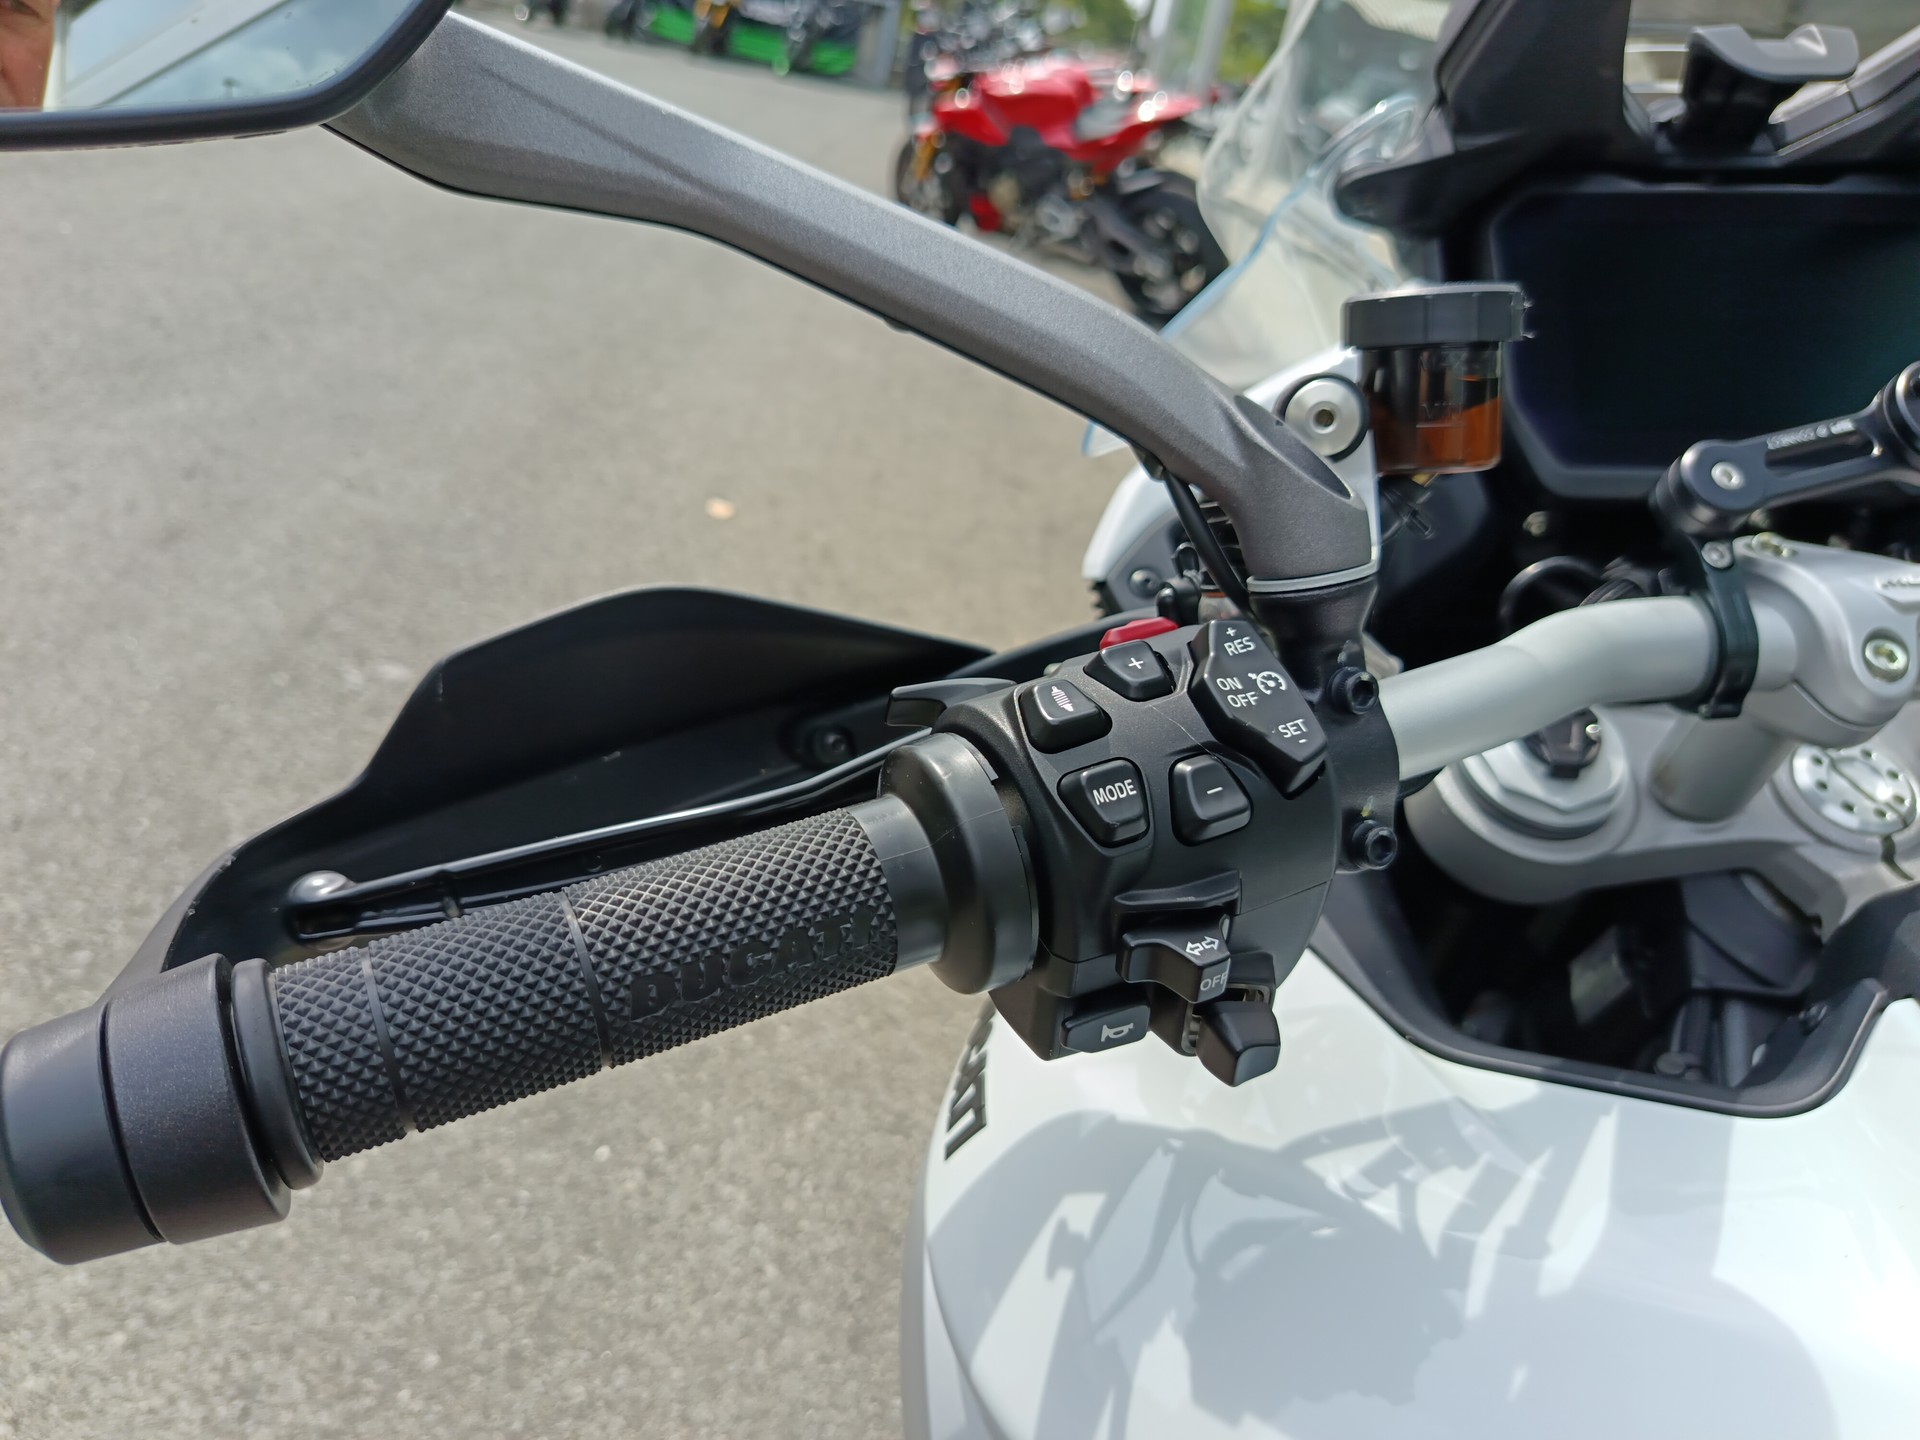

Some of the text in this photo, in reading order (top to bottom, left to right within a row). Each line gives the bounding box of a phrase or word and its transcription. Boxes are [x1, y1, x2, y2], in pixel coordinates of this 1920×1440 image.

[1223, 637, 1256, 656] RES
[1216, 677, 1243, 691] ON
[1226, 692, 1259, 708] OFF
[1278, 719, 1308, 738] SET
[1093, 779, 1137, 806] MODE
[628, 904, 873, 1022] DUCATI
[1200, 972, 1228, 991] OFF
